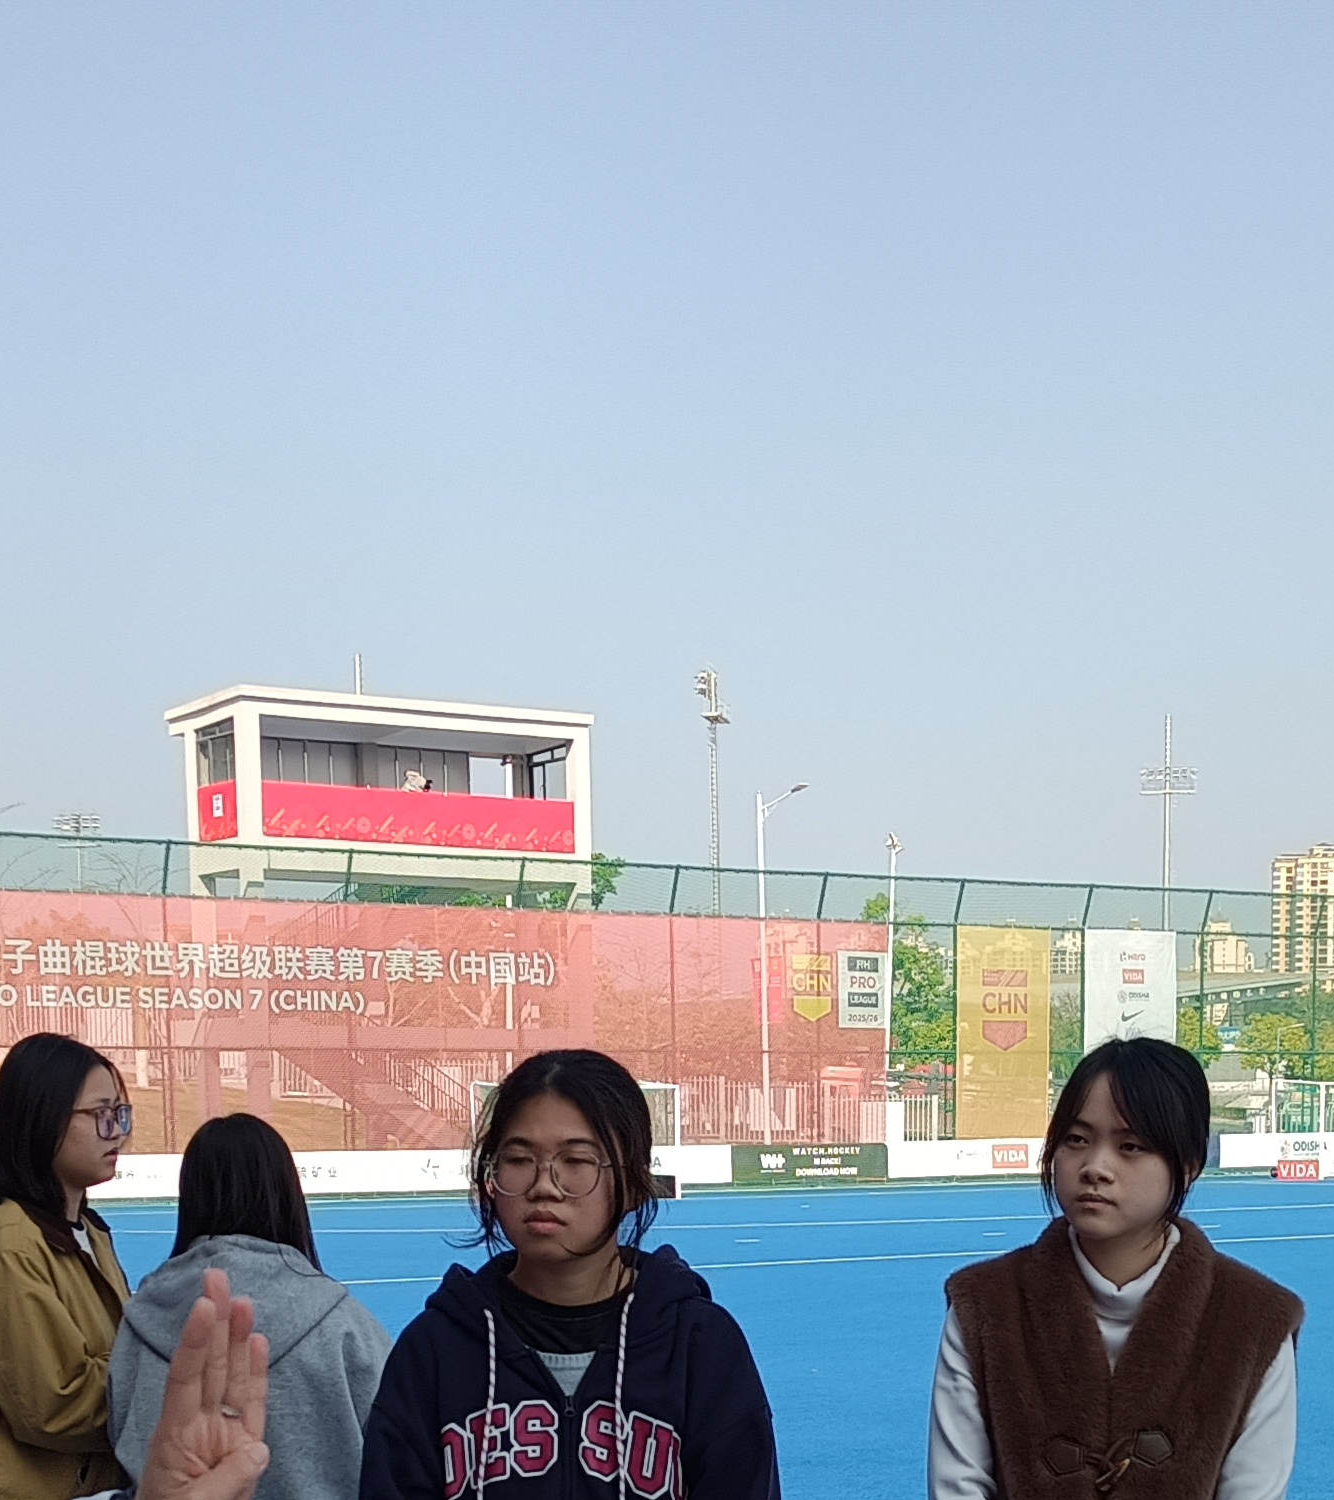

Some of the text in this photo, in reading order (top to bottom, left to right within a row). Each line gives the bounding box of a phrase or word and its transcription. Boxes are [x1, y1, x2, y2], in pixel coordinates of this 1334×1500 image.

[792, 973, 832, 992] CHN
[850, 976, 877, 989] PRO
[1124, 971, 1143, 981] VIDA
[26, 985, 132, 1009] LEAGUE
[138, 986, 241, 1010] SEASON
[249, 989, 263, 1010] 7
[270, 989, 366, 1015] (CHINA)
[982, 992, 1028, 1014] CHN
[792, 1147, 861, 1156] WATCH.HOCKEY
[993, 1149, 1027, 1163] VIDA
[1278, 1163, 1317, 1178] VIDA
